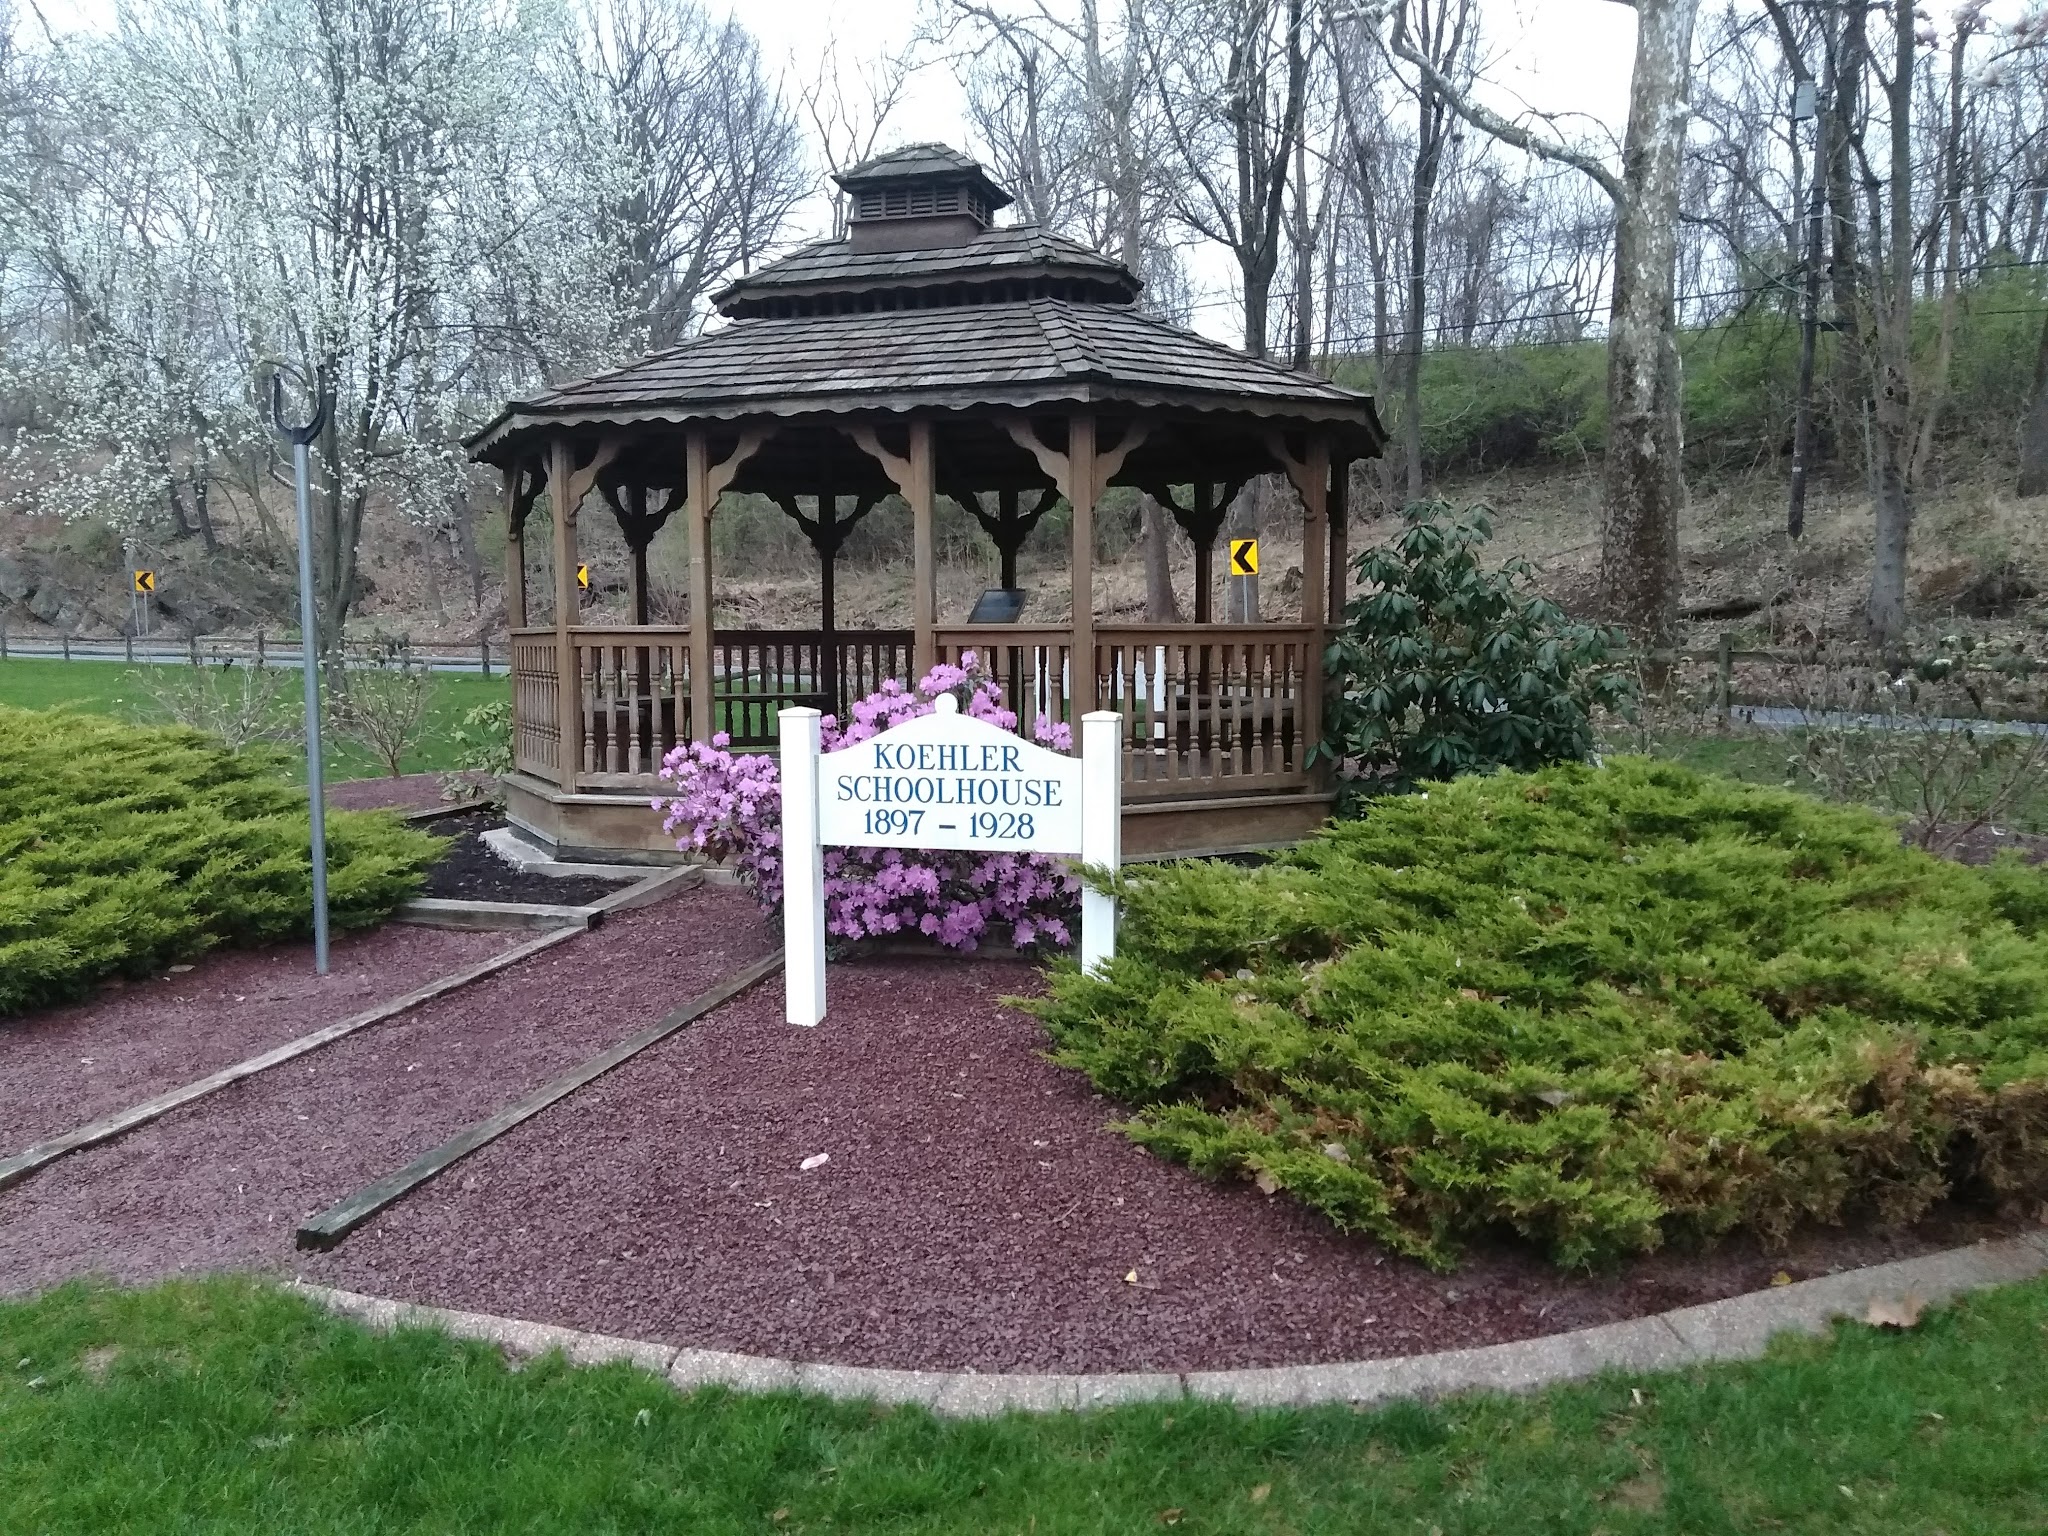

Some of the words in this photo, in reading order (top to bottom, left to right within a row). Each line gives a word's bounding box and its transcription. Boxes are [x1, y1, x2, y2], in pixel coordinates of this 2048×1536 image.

[873, 743, 1024, 772] KOEHLER
[837, 775, 1063, 806] SCHOOLHOUSE
[864, 808, 926, 836] 1897
[969, 811, 1035, 840] 1928
